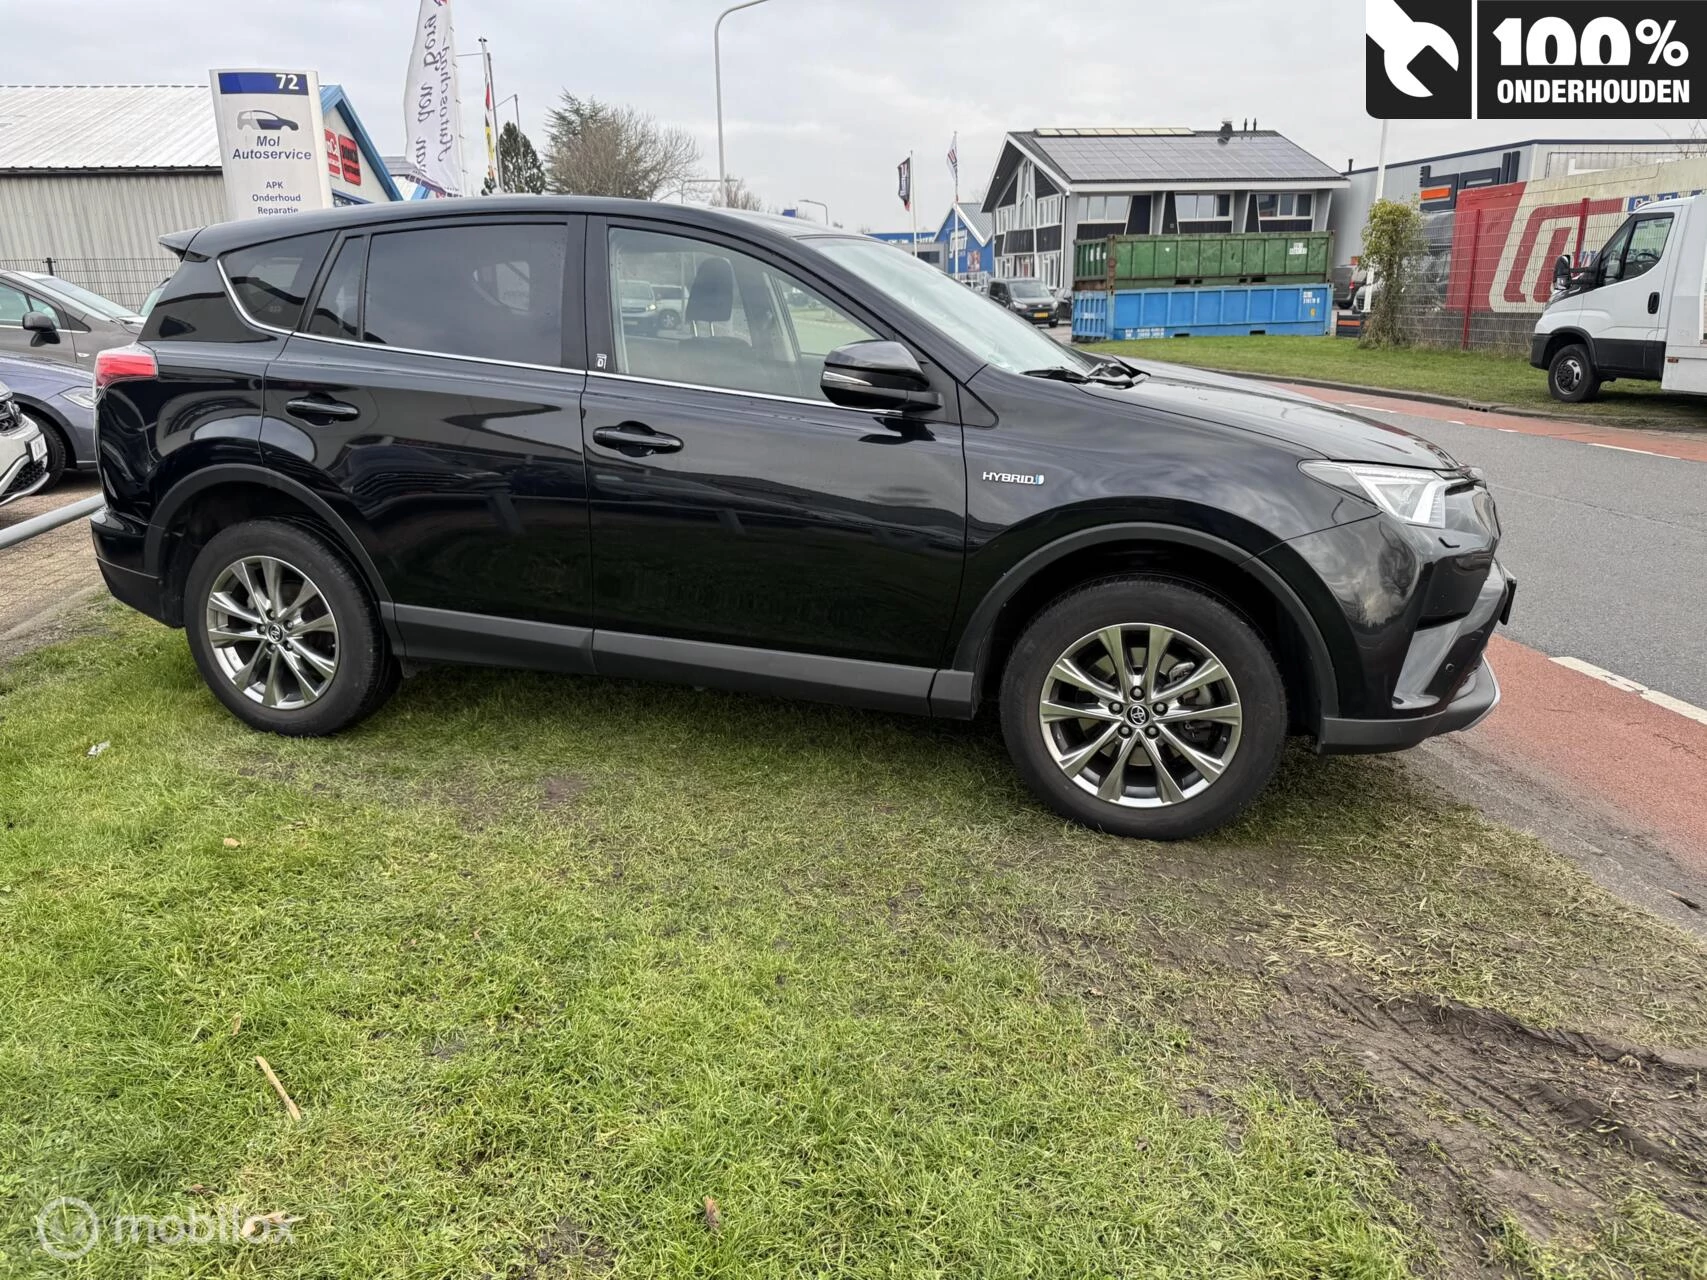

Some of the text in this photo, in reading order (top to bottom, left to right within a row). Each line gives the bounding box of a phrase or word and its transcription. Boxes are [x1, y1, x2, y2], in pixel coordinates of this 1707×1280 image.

[275, 74, 300, 90] 72
[256, 135, 281, 147] Mol
[232, 148, 312, 160] Autoservice
[265, 181, 284, 189] APK
[252, 193, 301, 202] Onderhoud
[257, 206, 299, 215] Reparatie
[982, 471, 1036, 485] HYBRID
